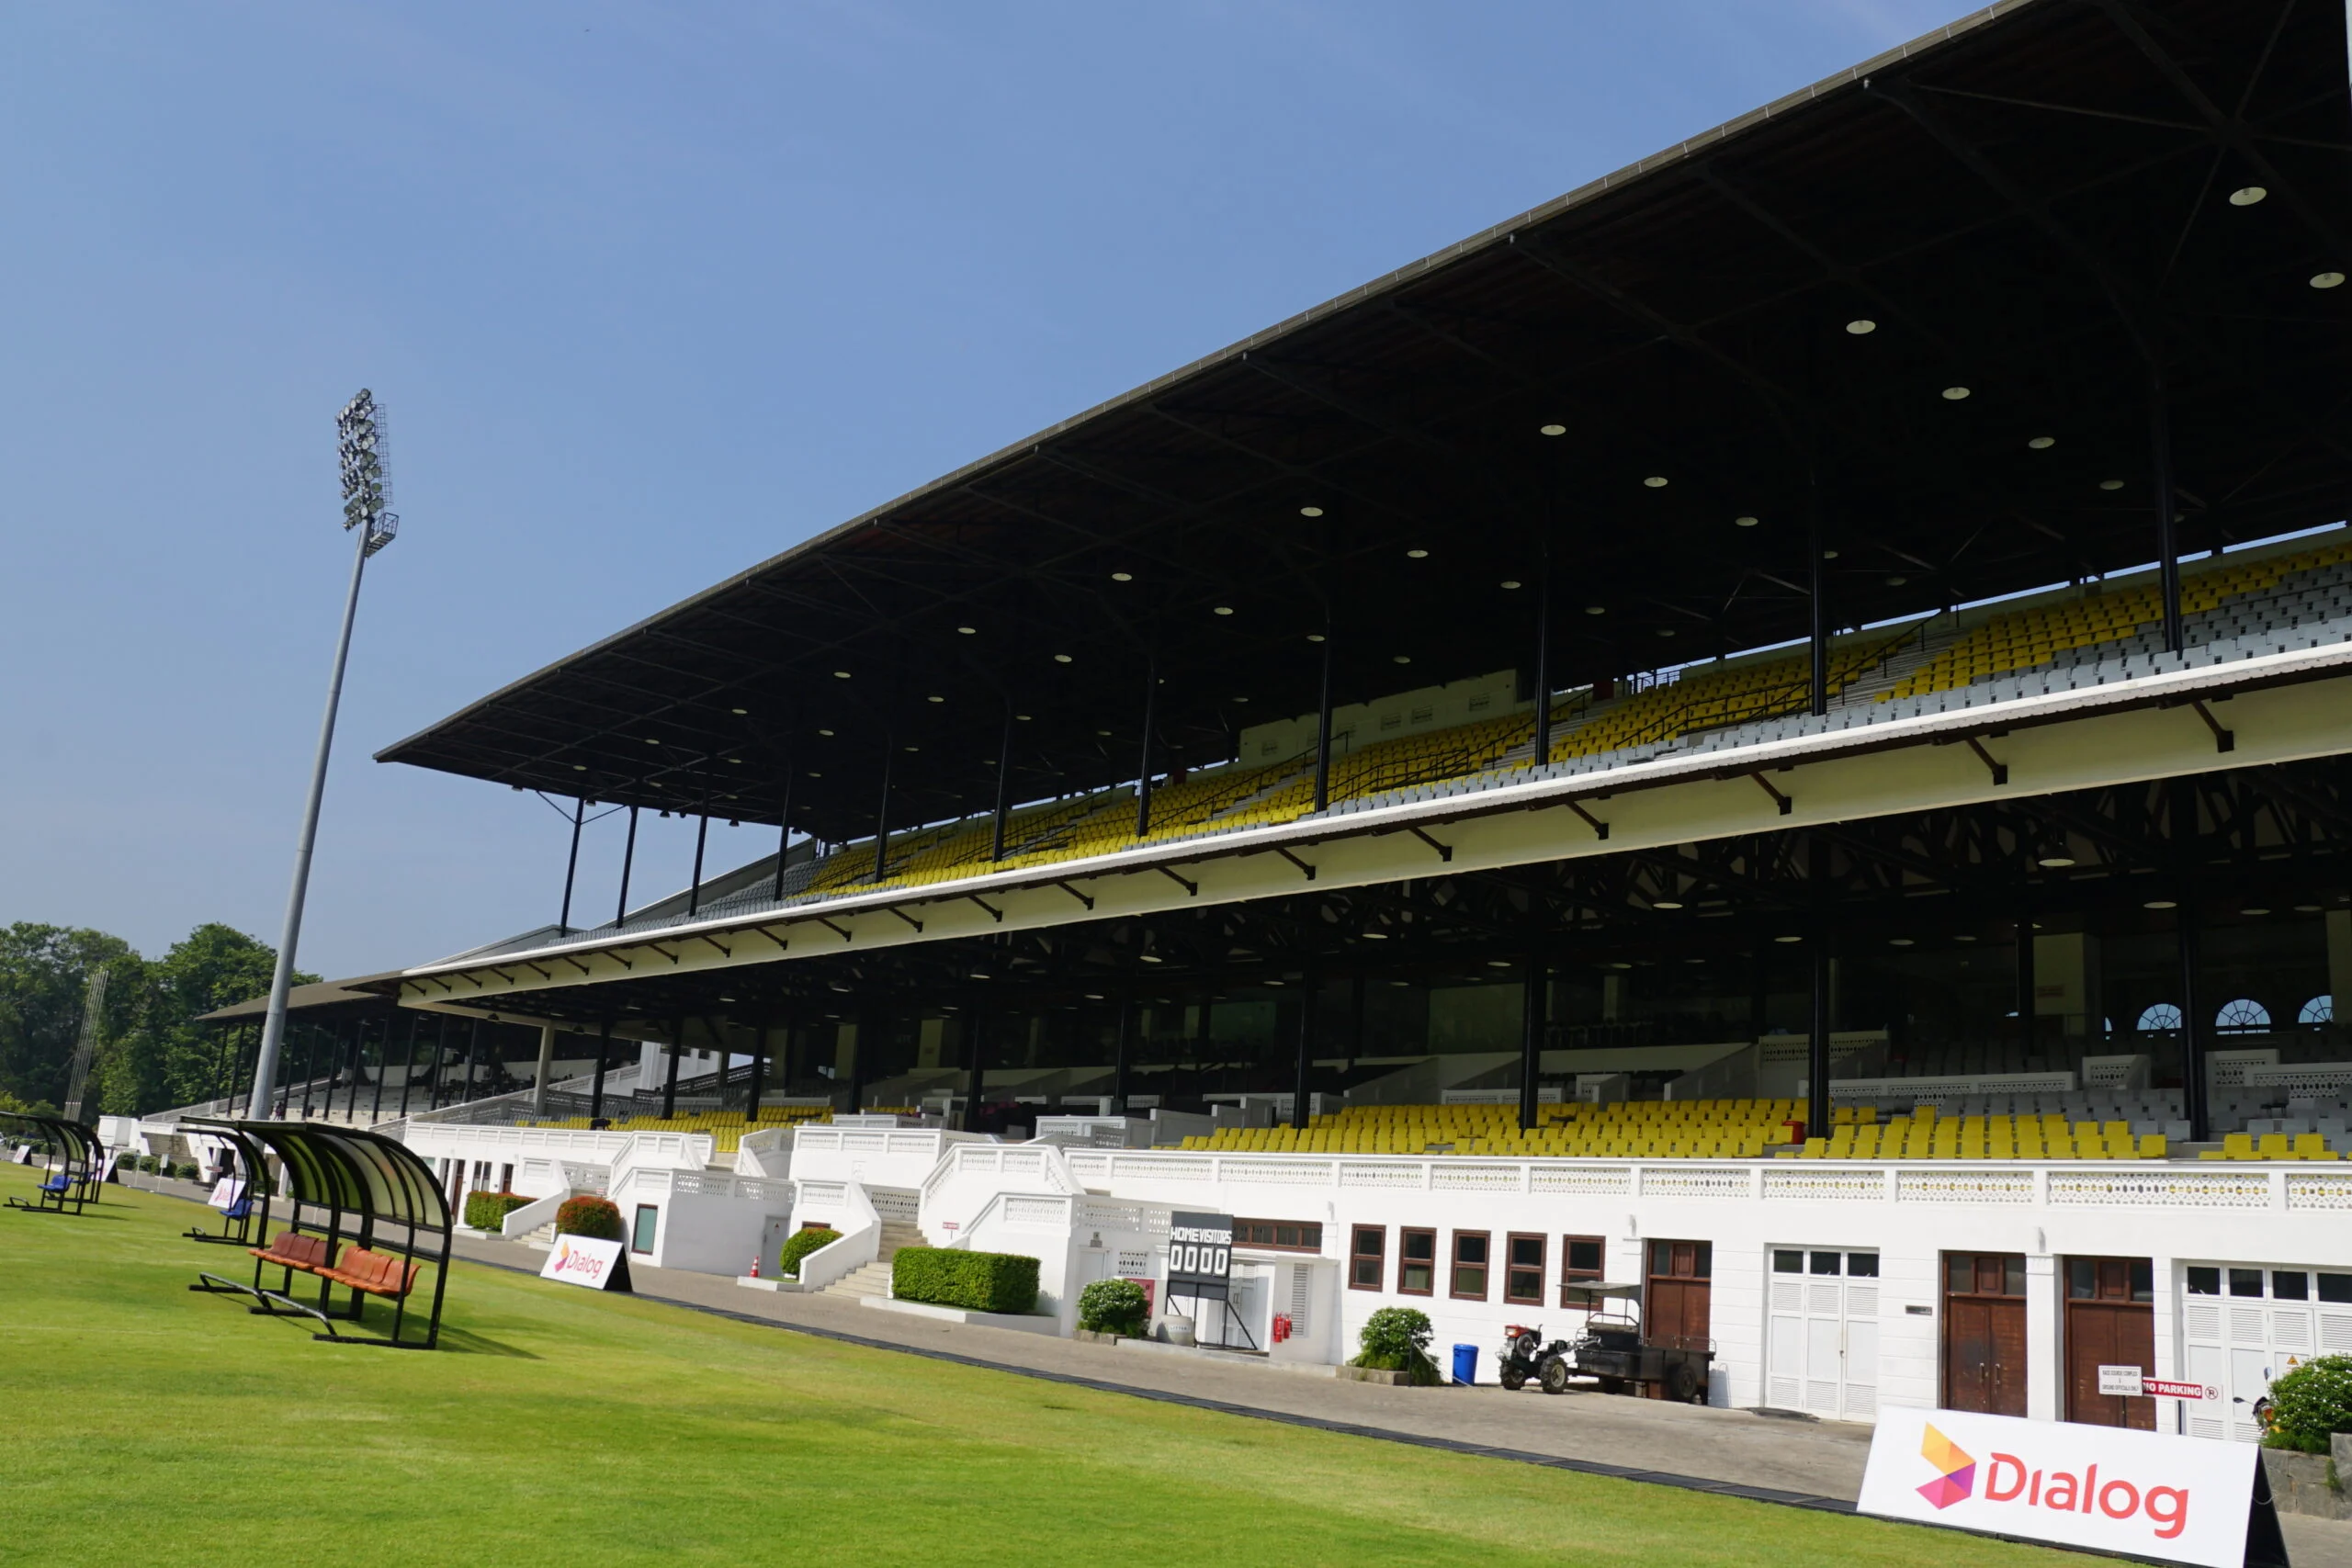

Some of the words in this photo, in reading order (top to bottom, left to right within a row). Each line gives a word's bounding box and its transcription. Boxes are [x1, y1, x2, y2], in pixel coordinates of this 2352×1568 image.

[1170, 1226, 1199, 1242] HOME
[1199, 1228, 1232, 1245] VISITORS
[567, 1249, 604, 1279] Dialog
[2143, 1382, 2156, 1392] NO
[2158, 1382, 2201, 1396] PARKING
[1984, 1452, 2189, 1540] Dialog
